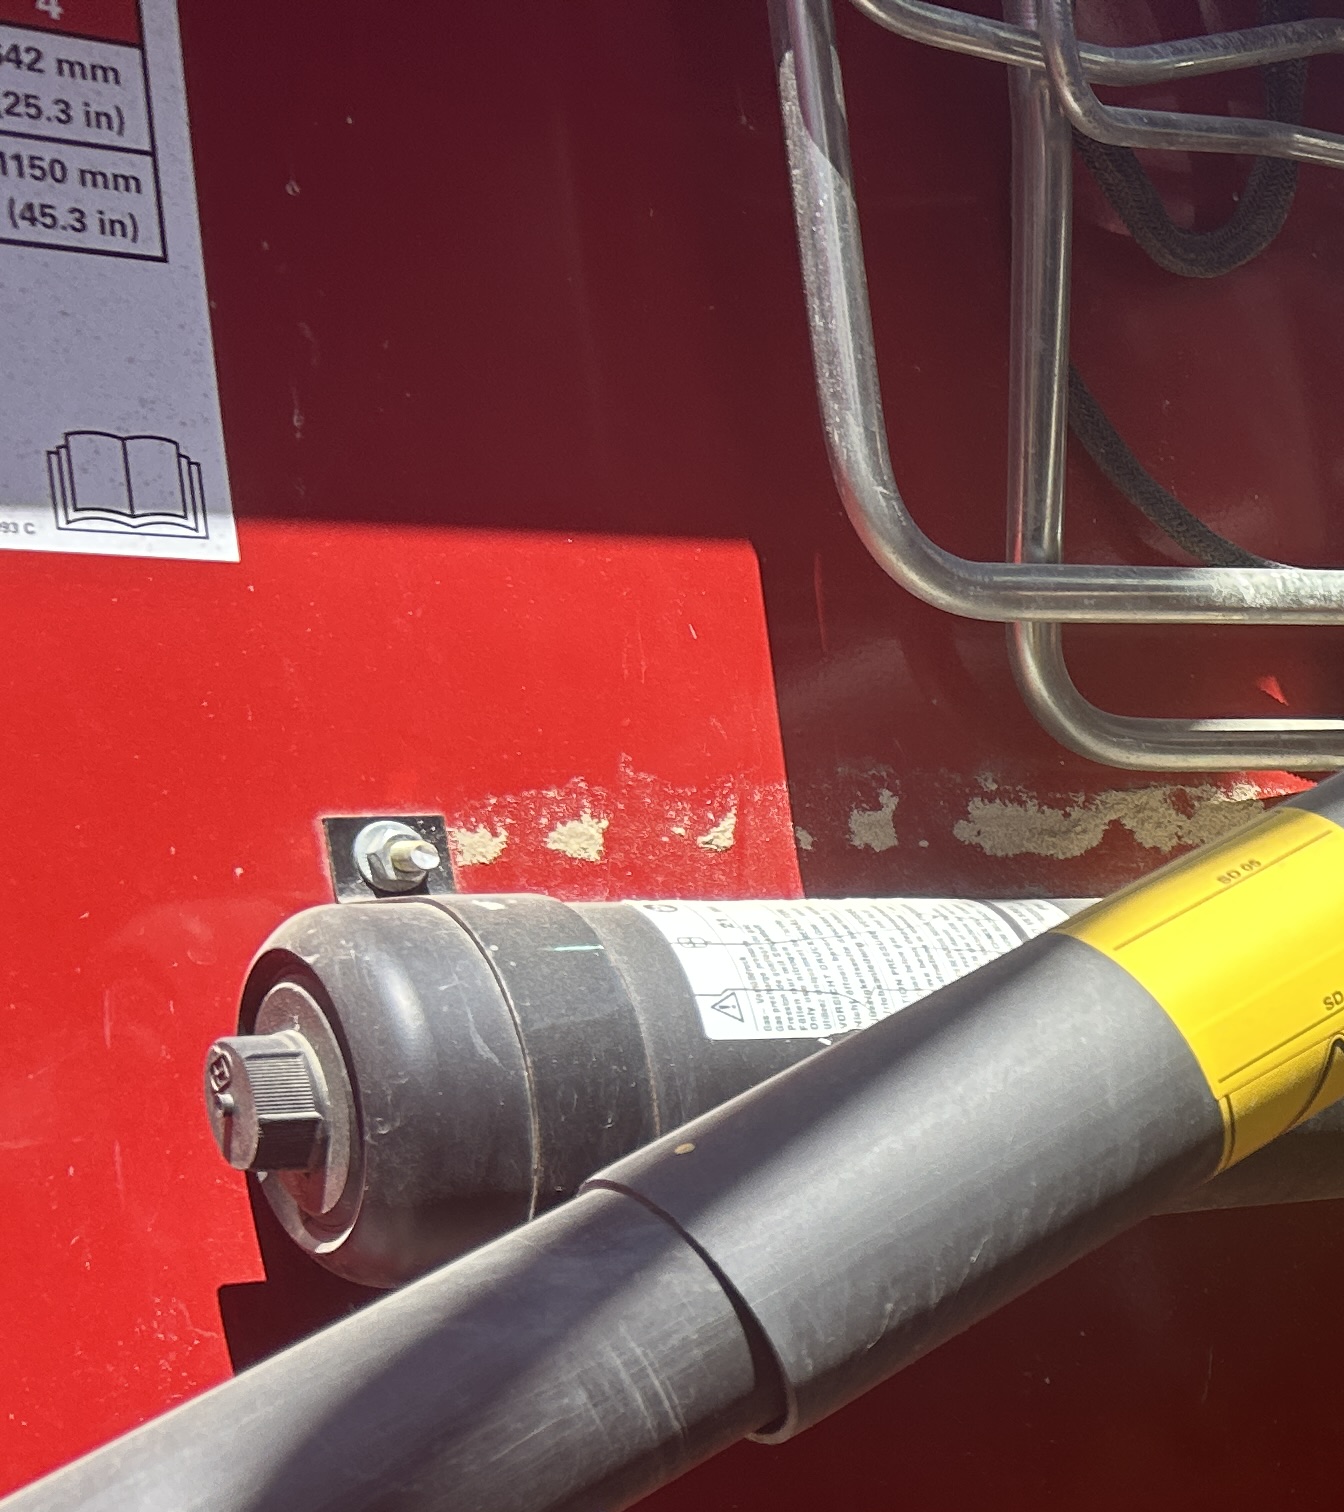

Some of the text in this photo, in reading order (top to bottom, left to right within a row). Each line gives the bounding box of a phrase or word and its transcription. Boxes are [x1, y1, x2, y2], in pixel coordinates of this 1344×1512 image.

[0, 43, 122, 86] 42 mm
[0, 90, 125, 137] 25.3 in)
[78, 167, 142, 194] mm
[8, 197, 139, 244] (45.3 in)
[1322, 990, 1344, 1011] SD
